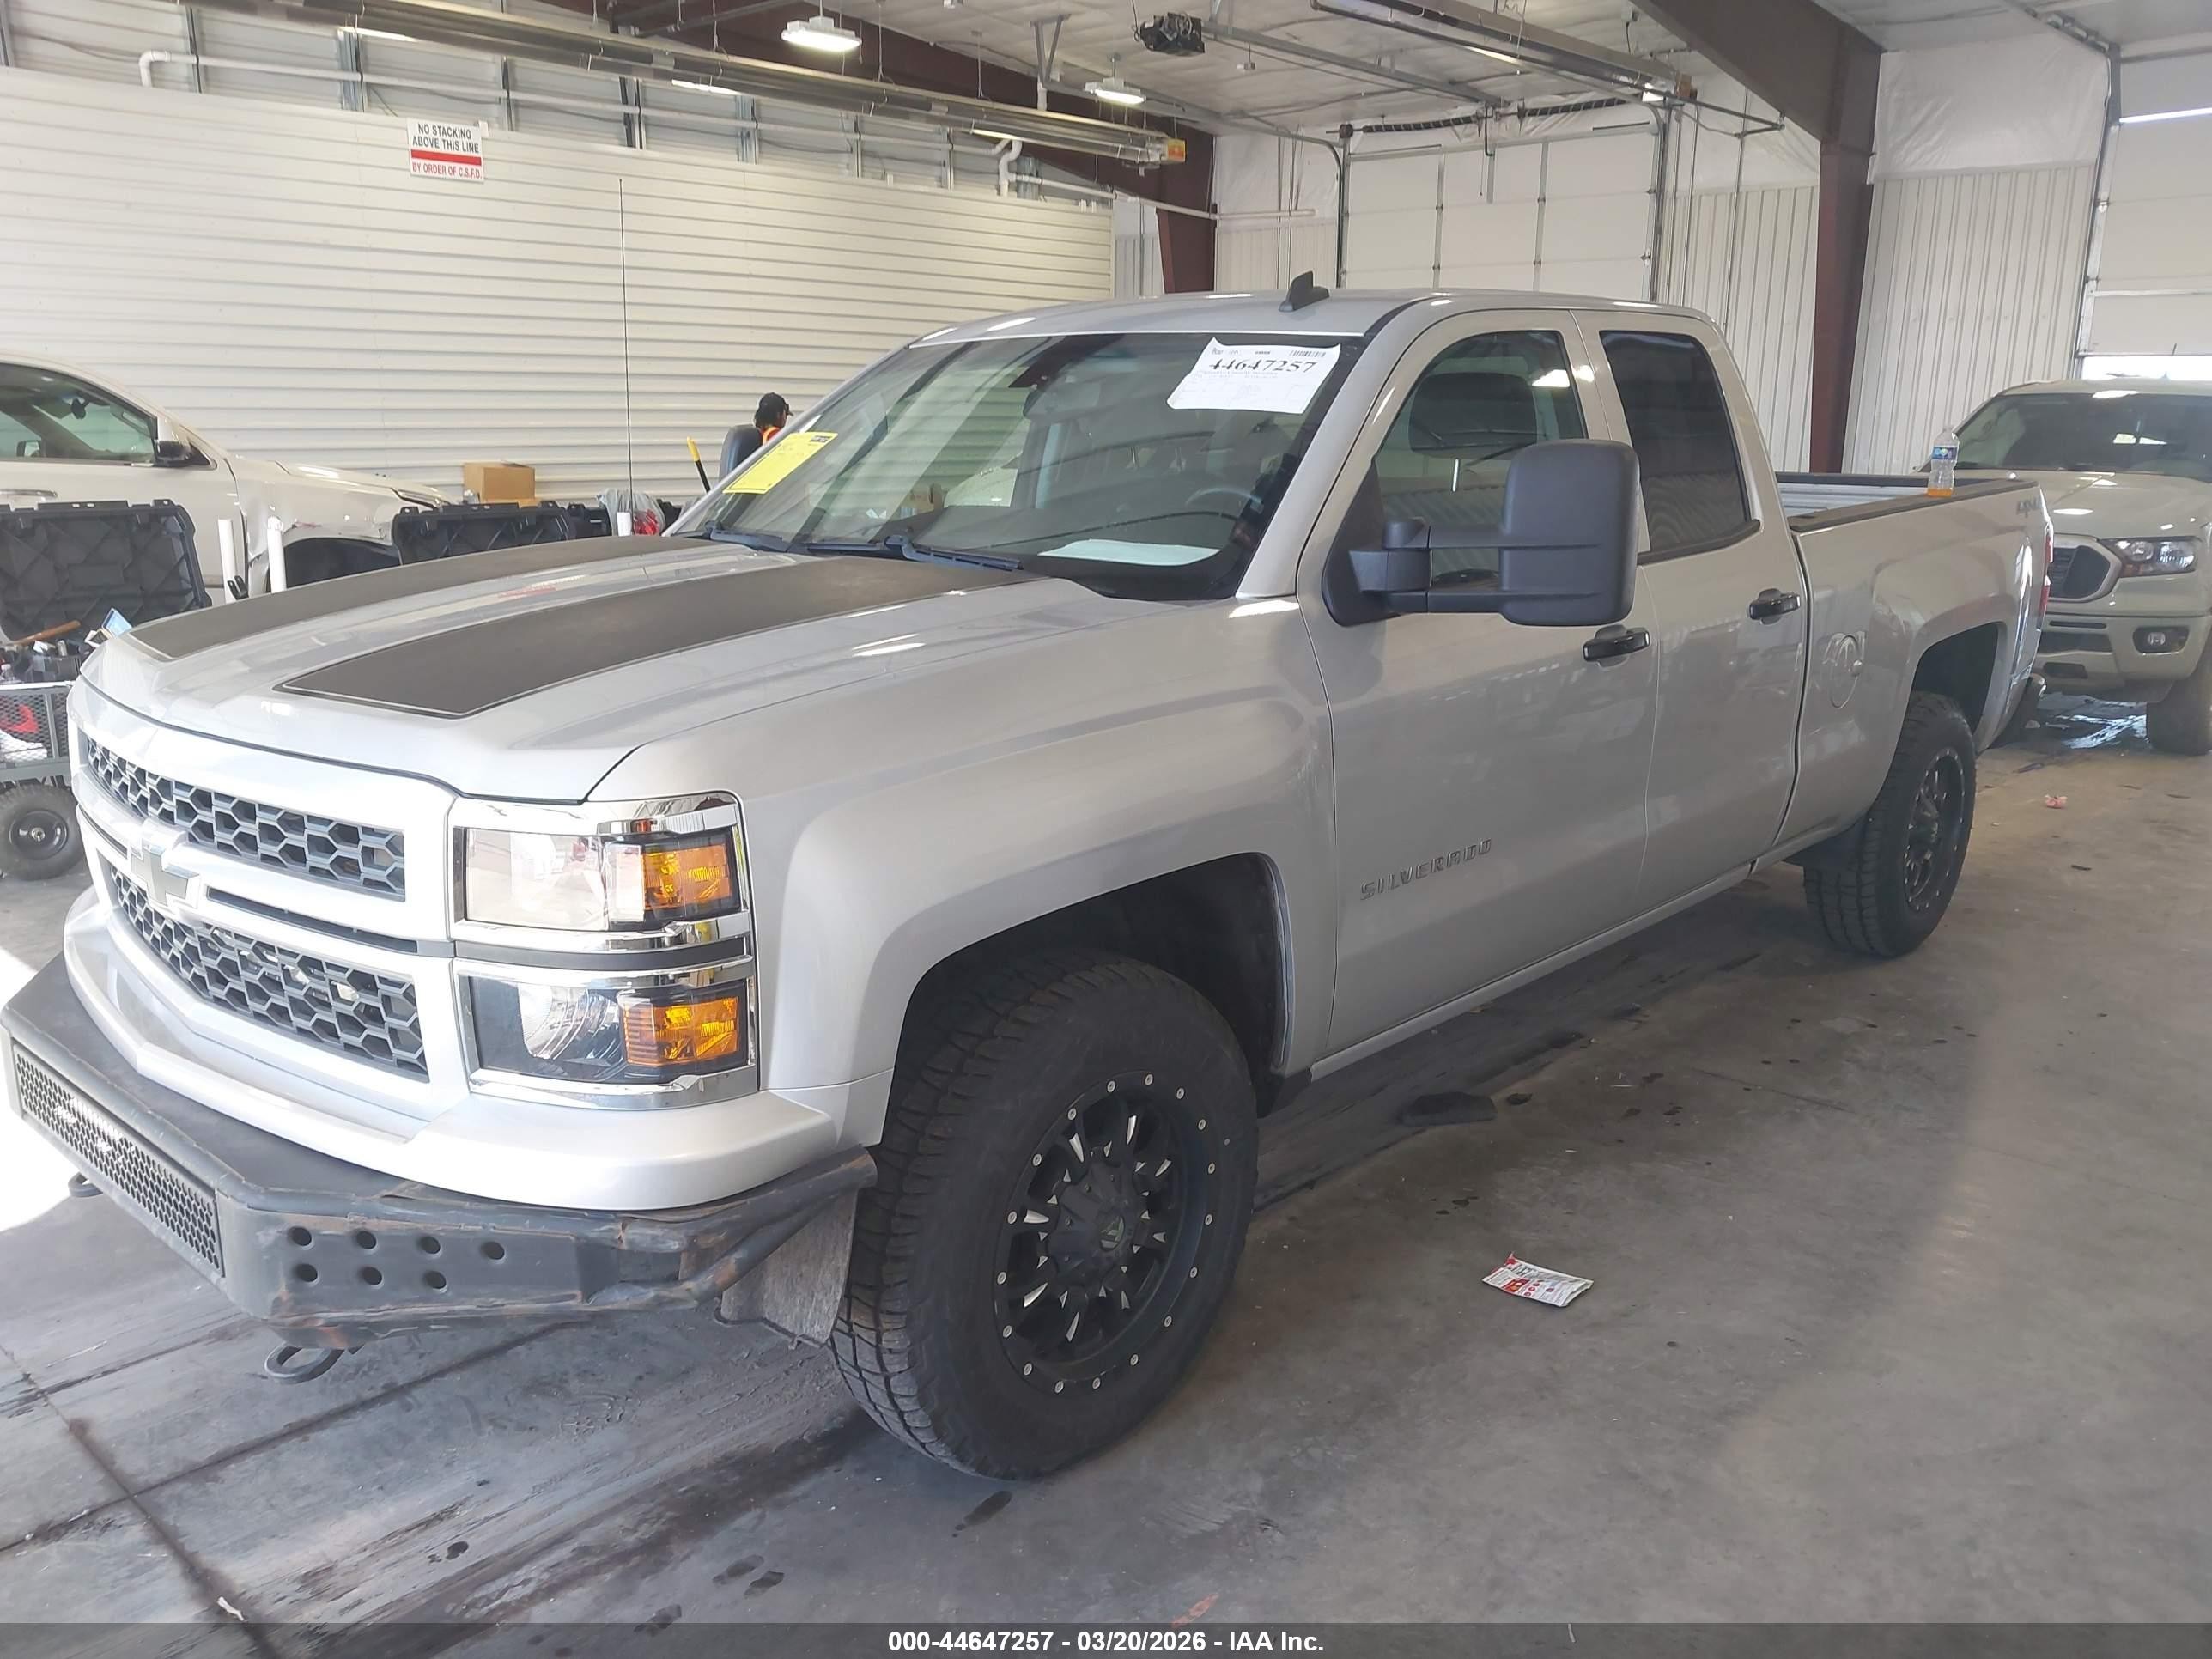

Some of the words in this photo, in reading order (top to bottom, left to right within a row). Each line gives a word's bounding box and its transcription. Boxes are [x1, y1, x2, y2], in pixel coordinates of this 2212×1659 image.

[418, 124, 430, 135] NO
[432, 125, 471, 139] STACKING
[412, 136, 441, 149] ABOVE
[442, 139, 459, 151] THIS
[462, 142, 479, 153] LINE
[412, 162, 421, 172] BY
[423, 163, 447, 174] ORDER
[447, 166, 456, 175] OF
[1209, 357, 1318, 373] 44647257
[1360, 838, 1492, 901] SILVERADO
